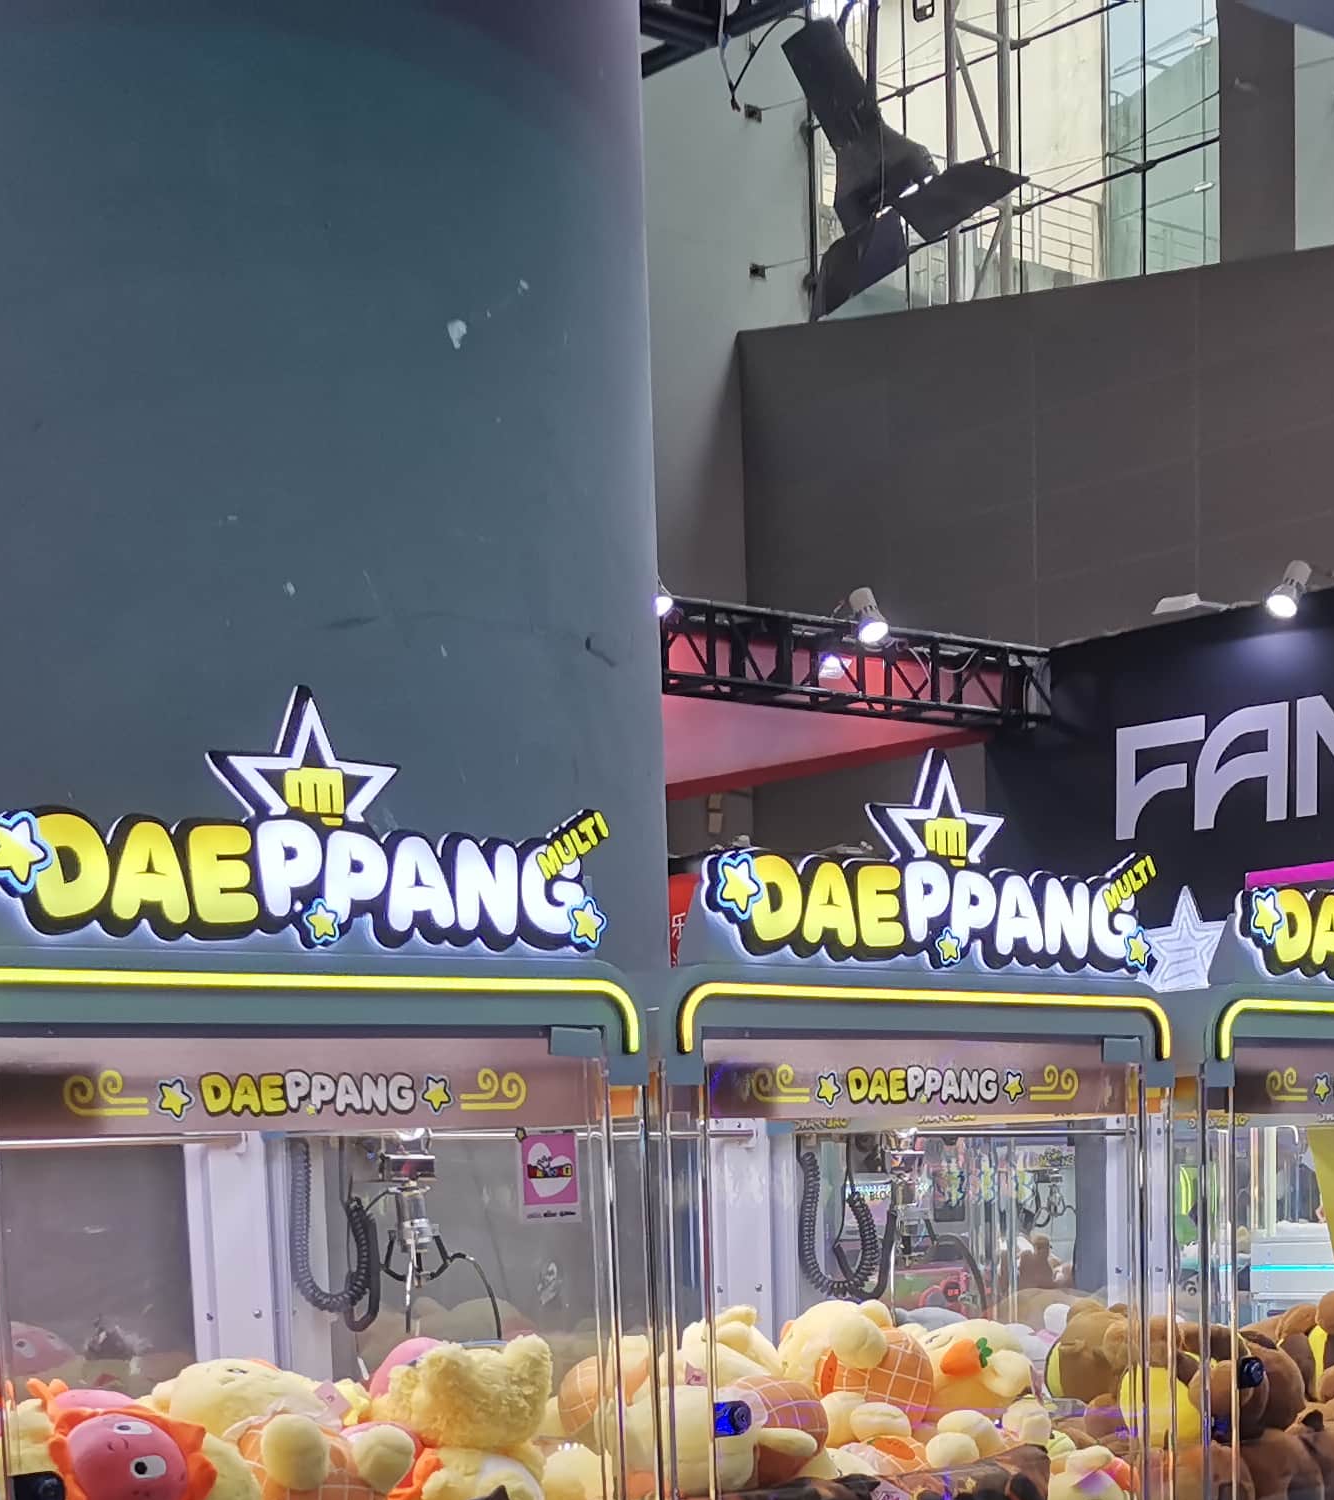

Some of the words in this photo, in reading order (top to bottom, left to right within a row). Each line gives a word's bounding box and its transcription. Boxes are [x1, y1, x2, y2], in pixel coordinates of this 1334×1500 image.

[32, 812, 583, 936] DAEPPANG
[535, 810, 610, 880] MULTI
[750, 854, 1139, 961] DAEPPANG
[1103, 854, 1158, 913] MULTI
[201, 1070, 417, 1117] DAEPPANG
[847, 1065, 998, 1105] DAEPPANG
